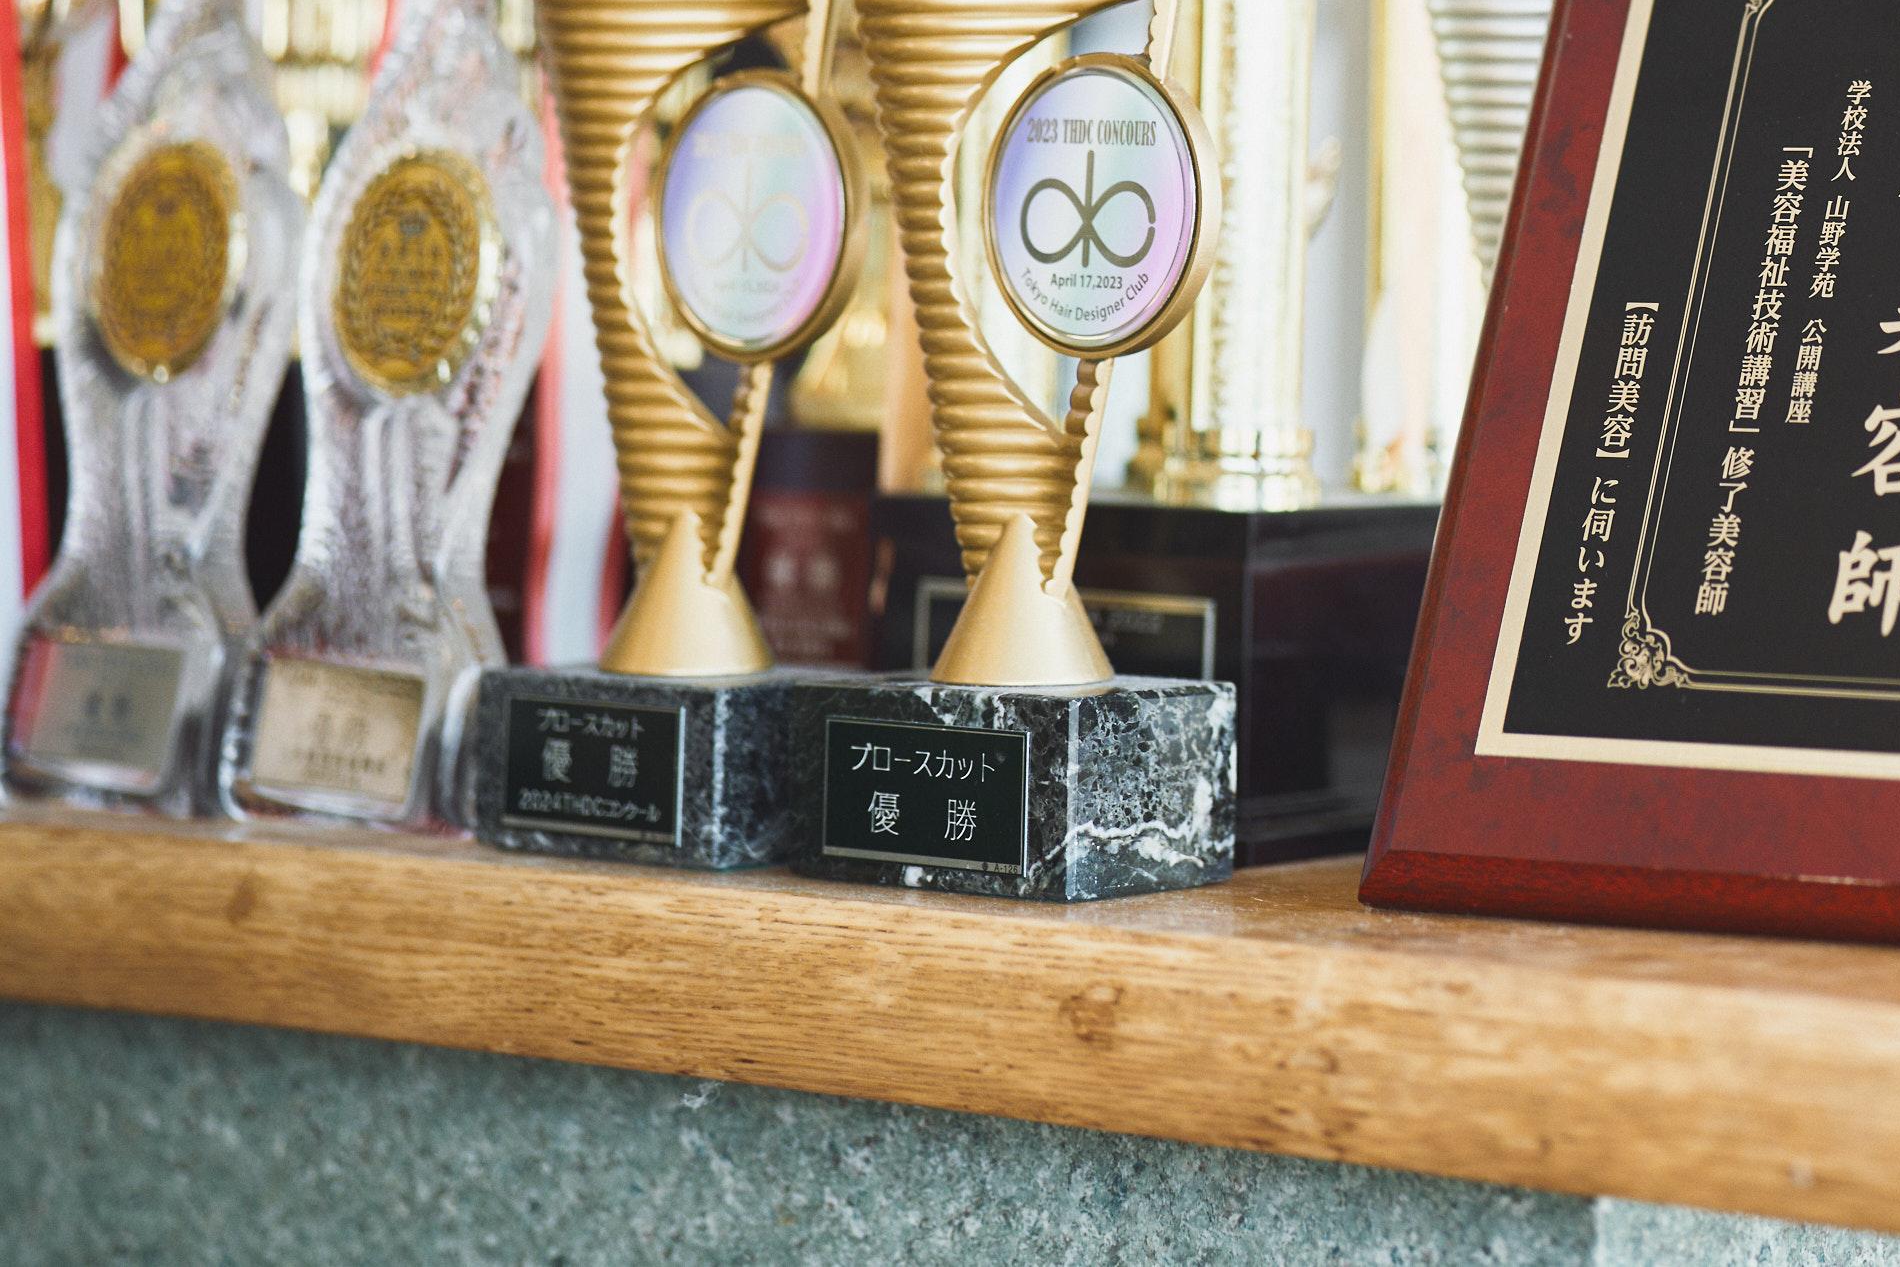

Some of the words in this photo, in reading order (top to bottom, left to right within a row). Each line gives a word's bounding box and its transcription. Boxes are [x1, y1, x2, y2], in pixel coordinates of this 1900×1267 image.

[1027, 117, 1058, 143] 2023
[1063, 119, 1094, 144] THDC
[1097, 119, 1157, 147] CONCOURS
[1830, 79, 1873, 182] 学校法人
[1050, 273, 1077, 290] April
[1080, 274, 1123, 290] 17,2023
[1808, 194, 1851, 299] 山野学苑
[1020, 267, 1049, 305] Tokyo
[1048, 297, 1073, 319] Hair
[1074, 297, 1125, 322] Designer
[1125, 273, 1149, 301] Club
[1784, 318, 1828, 424] 公開講座
